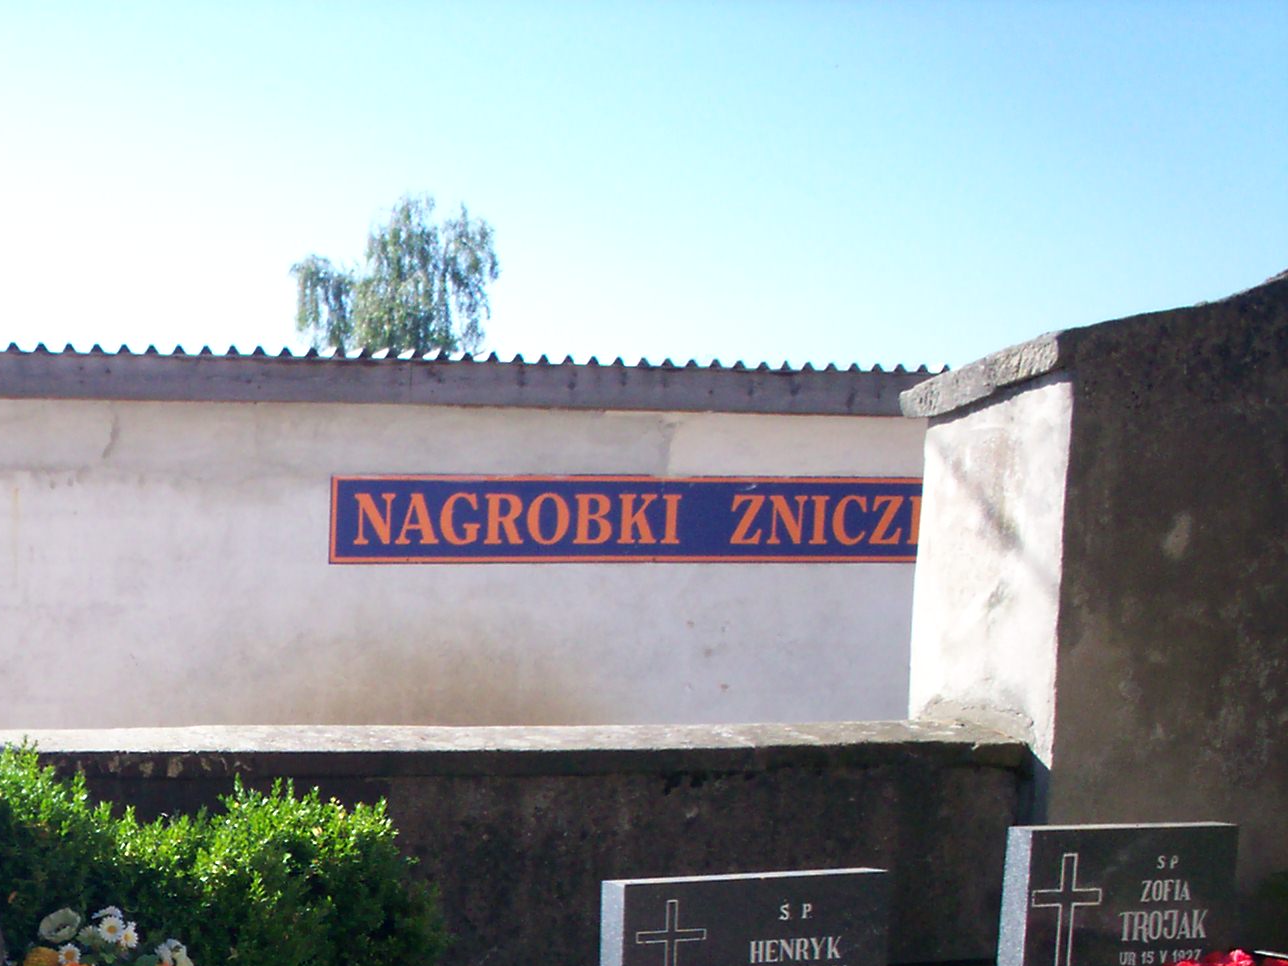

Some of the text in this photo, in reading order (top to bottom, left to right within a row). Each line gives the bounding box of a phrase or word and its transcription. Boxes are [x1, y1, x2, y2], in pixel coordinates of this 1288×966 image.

[353, 492, 681, 546] NAGROBKI
[1140, 879, 1191, 903] ZOFIA
[1119, 908, 1209, 943] TROJAK
[749, 935, 843, 964] HENRYK
